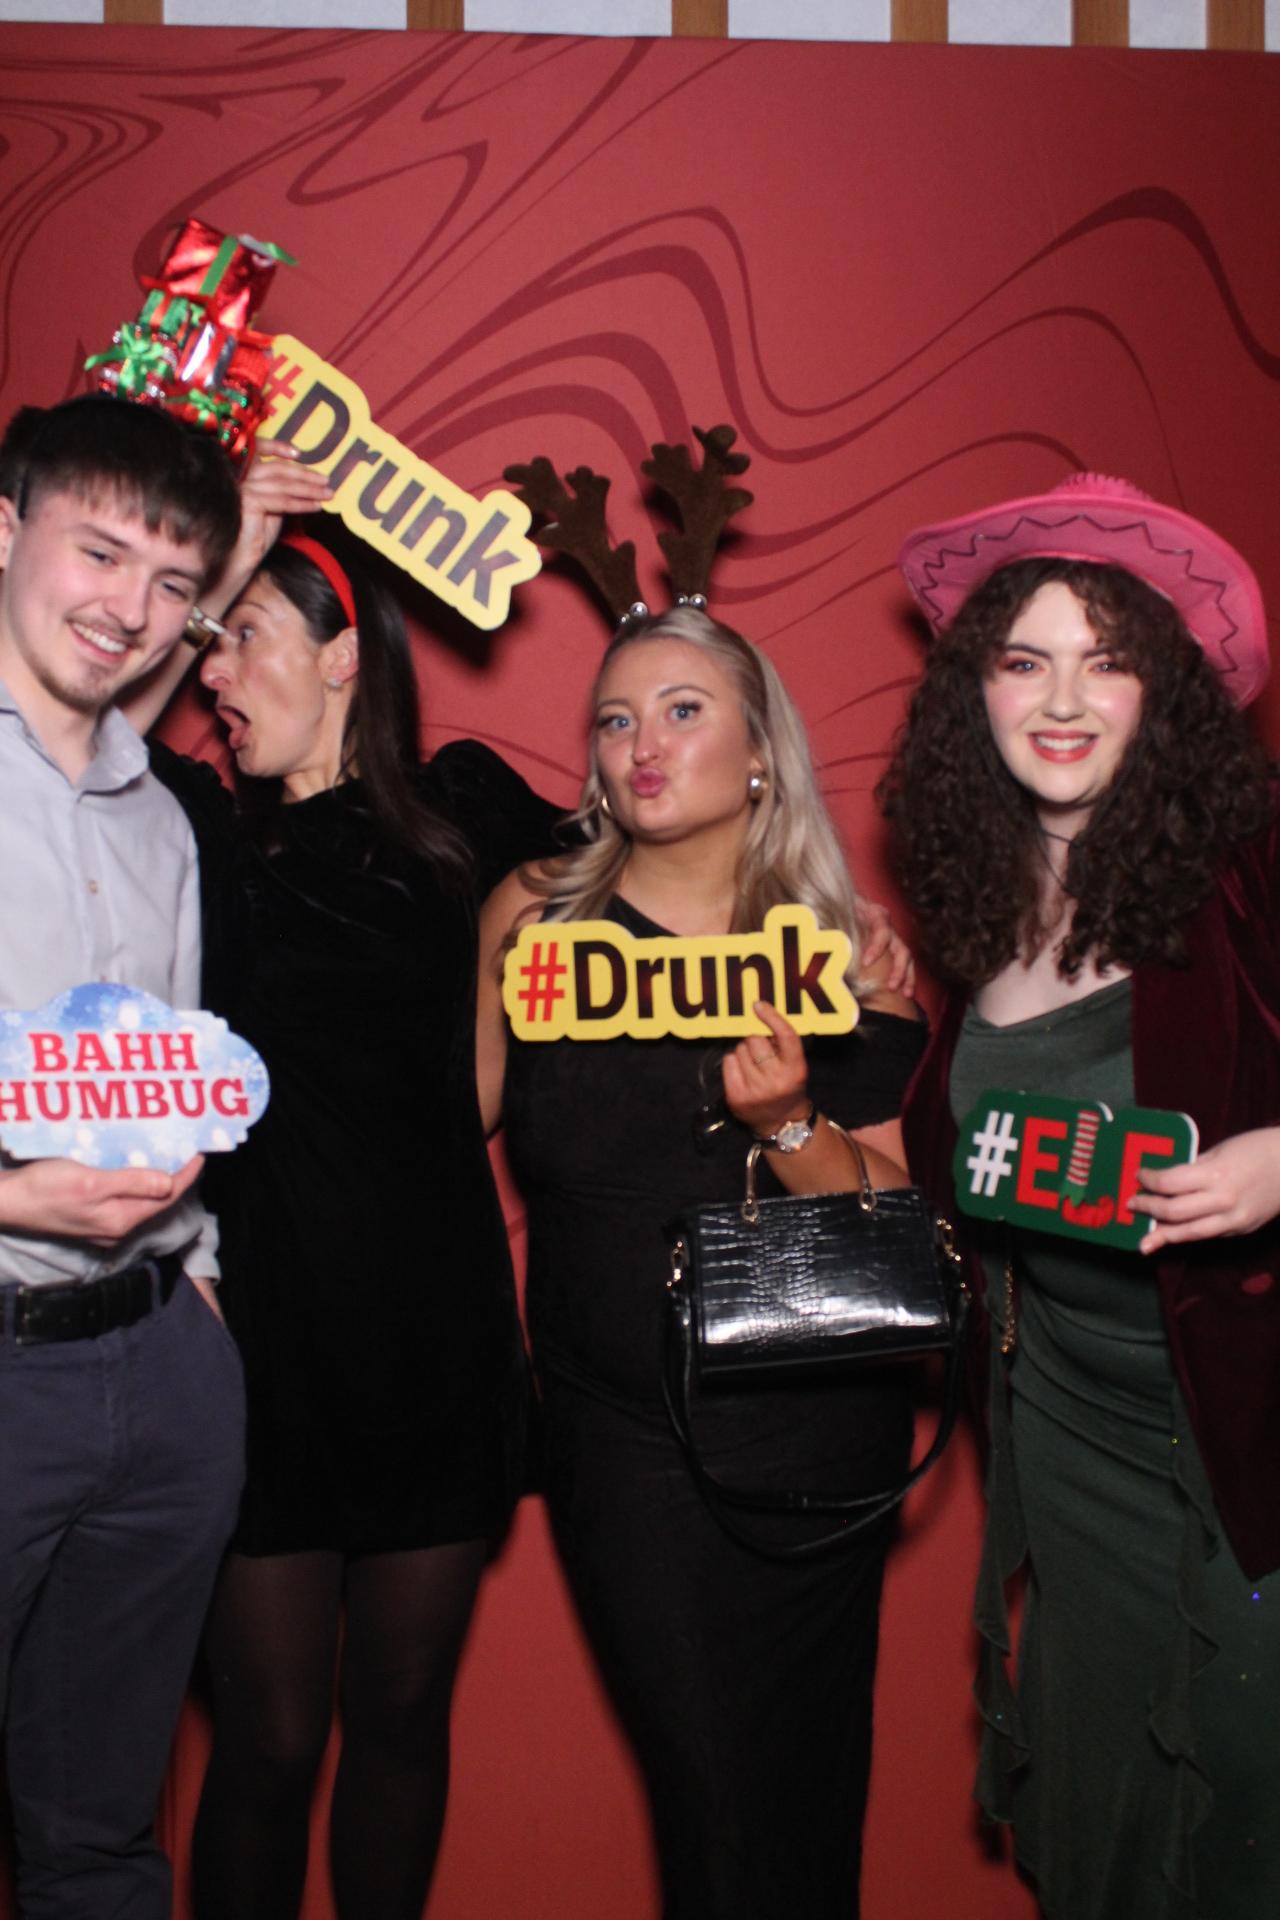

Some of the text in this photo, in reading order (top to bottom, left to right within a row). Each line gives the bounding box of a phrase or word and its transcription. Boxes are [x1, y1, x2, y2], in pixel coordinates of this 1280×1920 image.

[517, 926, 838, 1022] #Drunk
[28, 1032, 199, 1073] BAHH
[0, 1078, 248, 1122] HUMBUG
